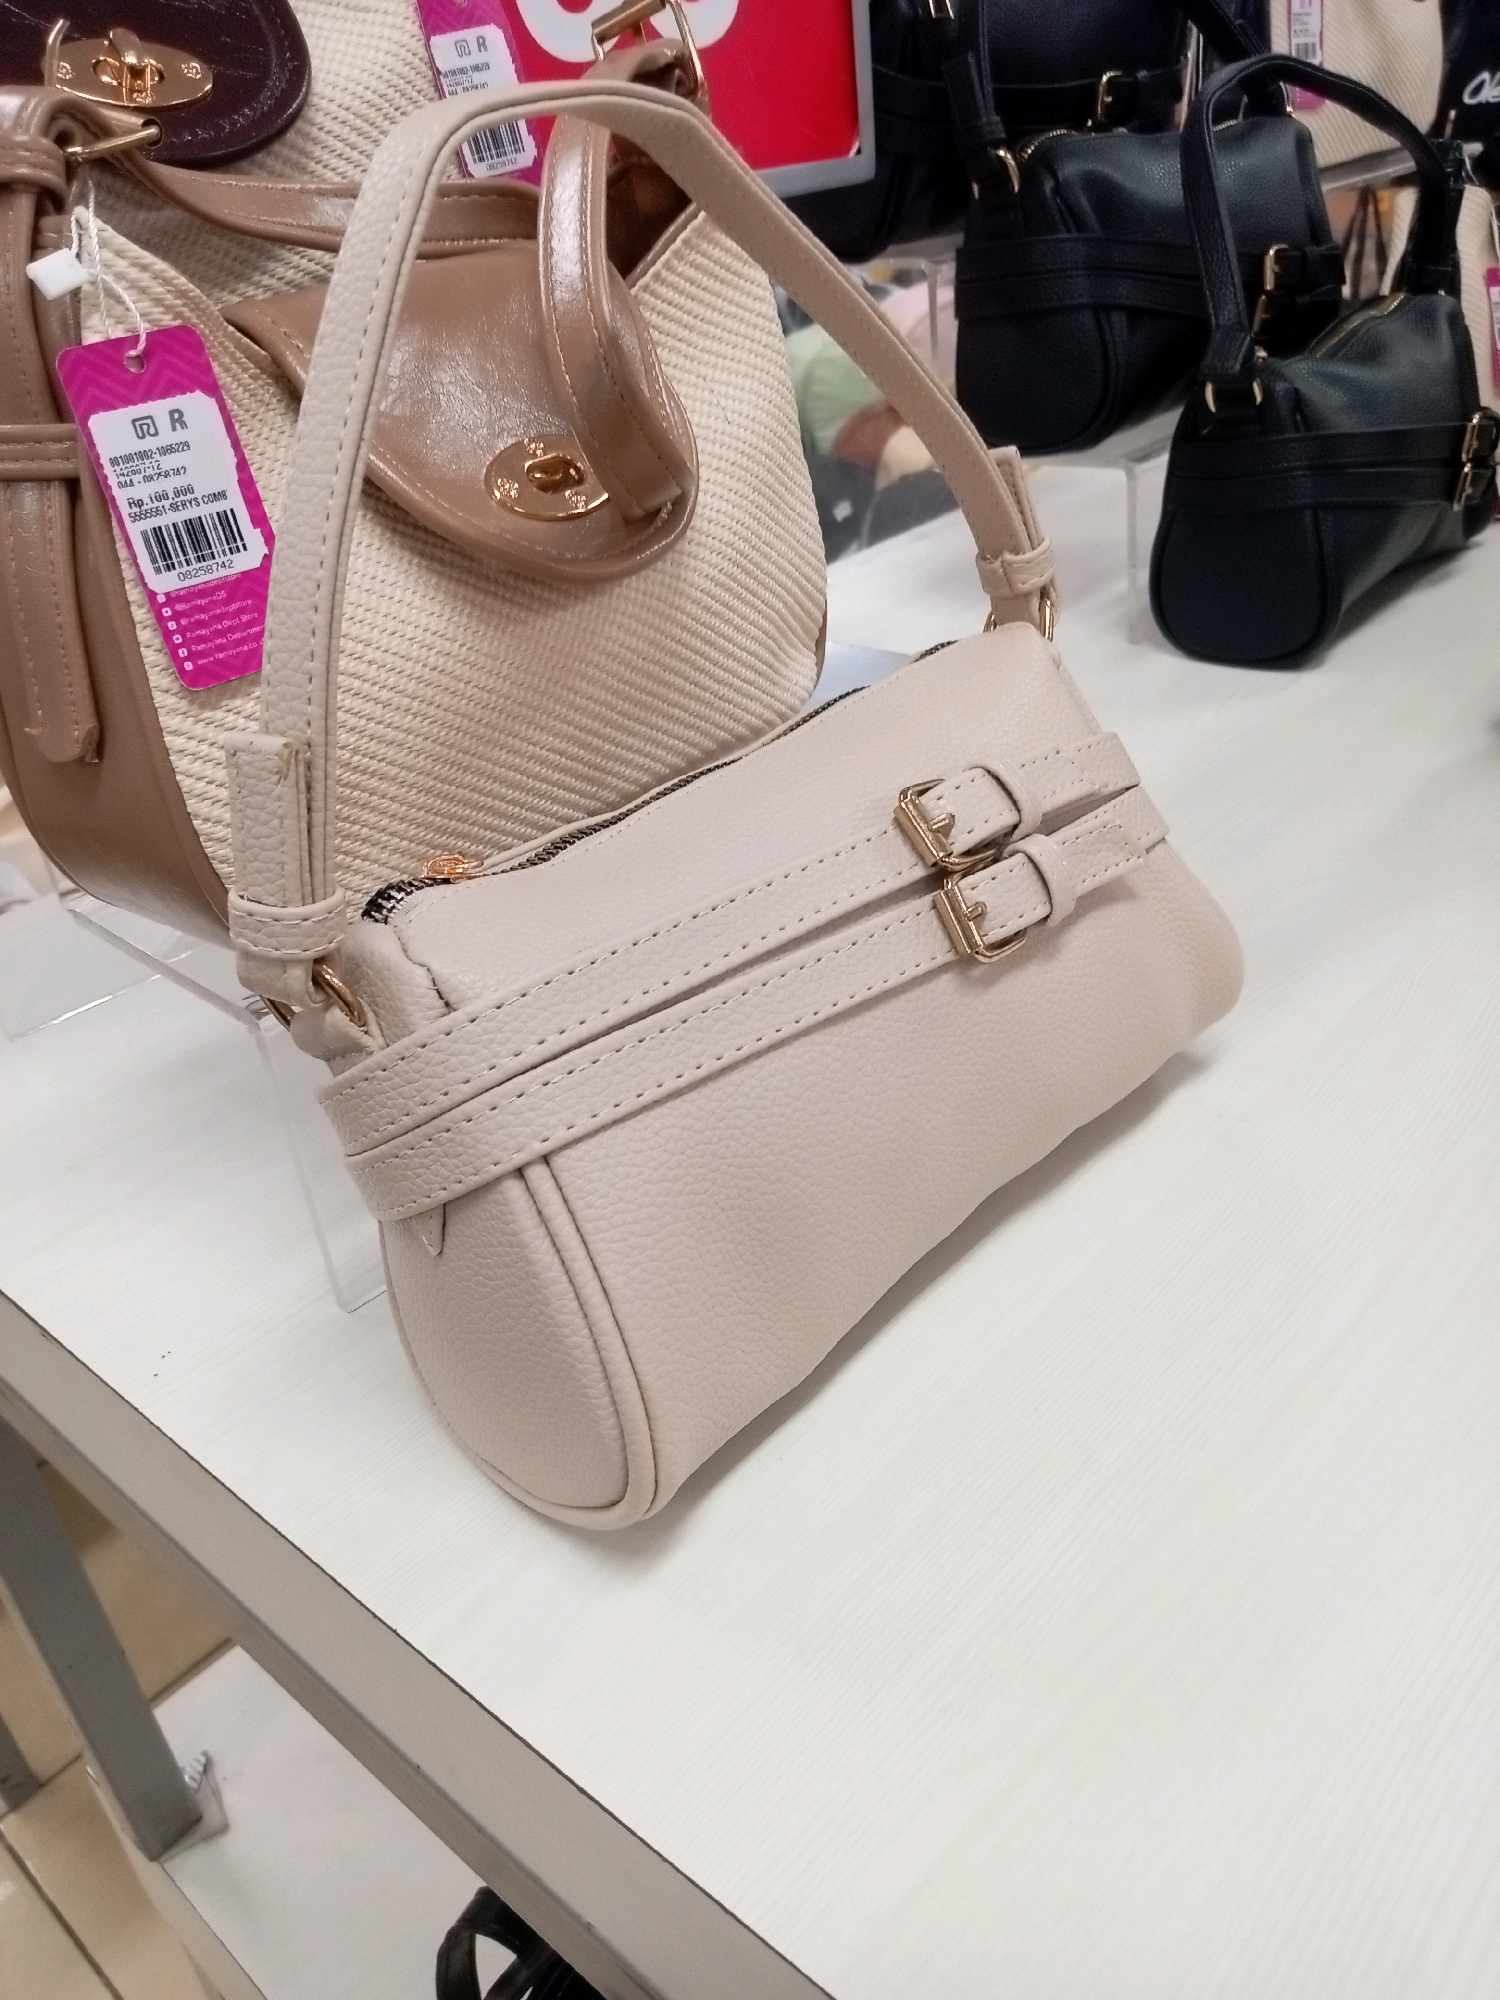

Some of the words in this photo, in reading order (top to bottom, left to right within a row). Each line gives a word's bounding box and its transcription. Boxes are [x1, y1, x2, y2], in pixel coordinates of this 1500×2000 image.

[475, 35, 489, 53] R
[168, 408, 189, 432] R
[177, 558, 235, 582] 08258742
[186, 624, 222, 639] Ramayana
[222, 616, 241, 629] Dept
[240, 612, 259, 623] Store
[191, 637, 227, 652] Ramayana
